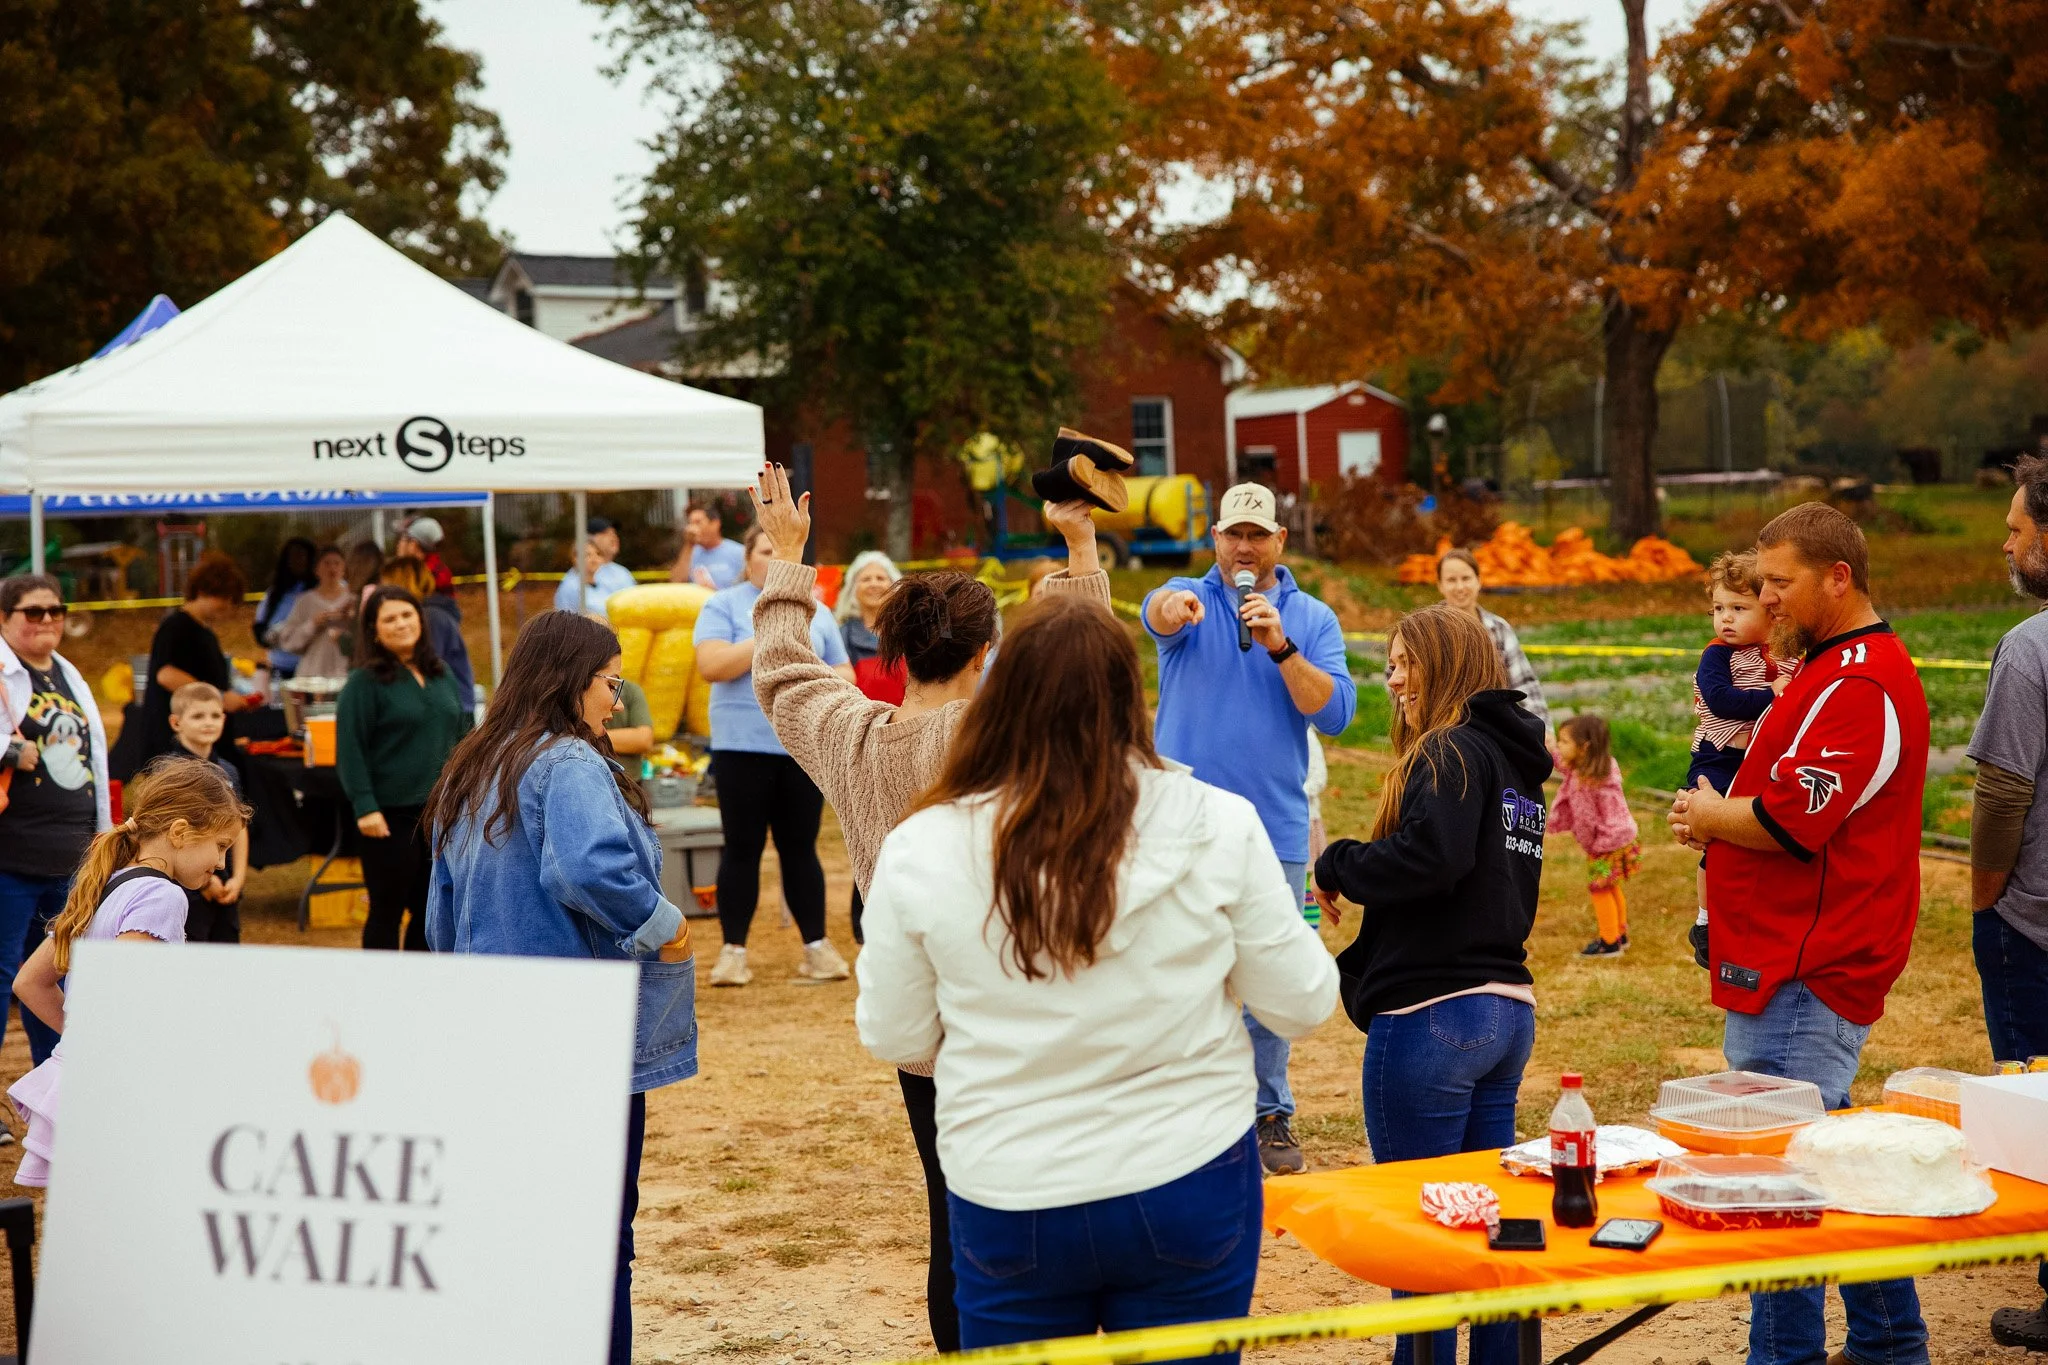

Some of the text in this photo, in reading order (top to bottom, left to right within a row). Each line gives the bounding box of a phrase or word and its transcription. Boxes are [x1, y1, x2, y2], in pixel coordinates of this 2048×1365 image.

[313, 416, 526, 472] next Steps
[209, 1124, 444, 1208] CAKE
[202, 1210, 441, 1291] WALK
